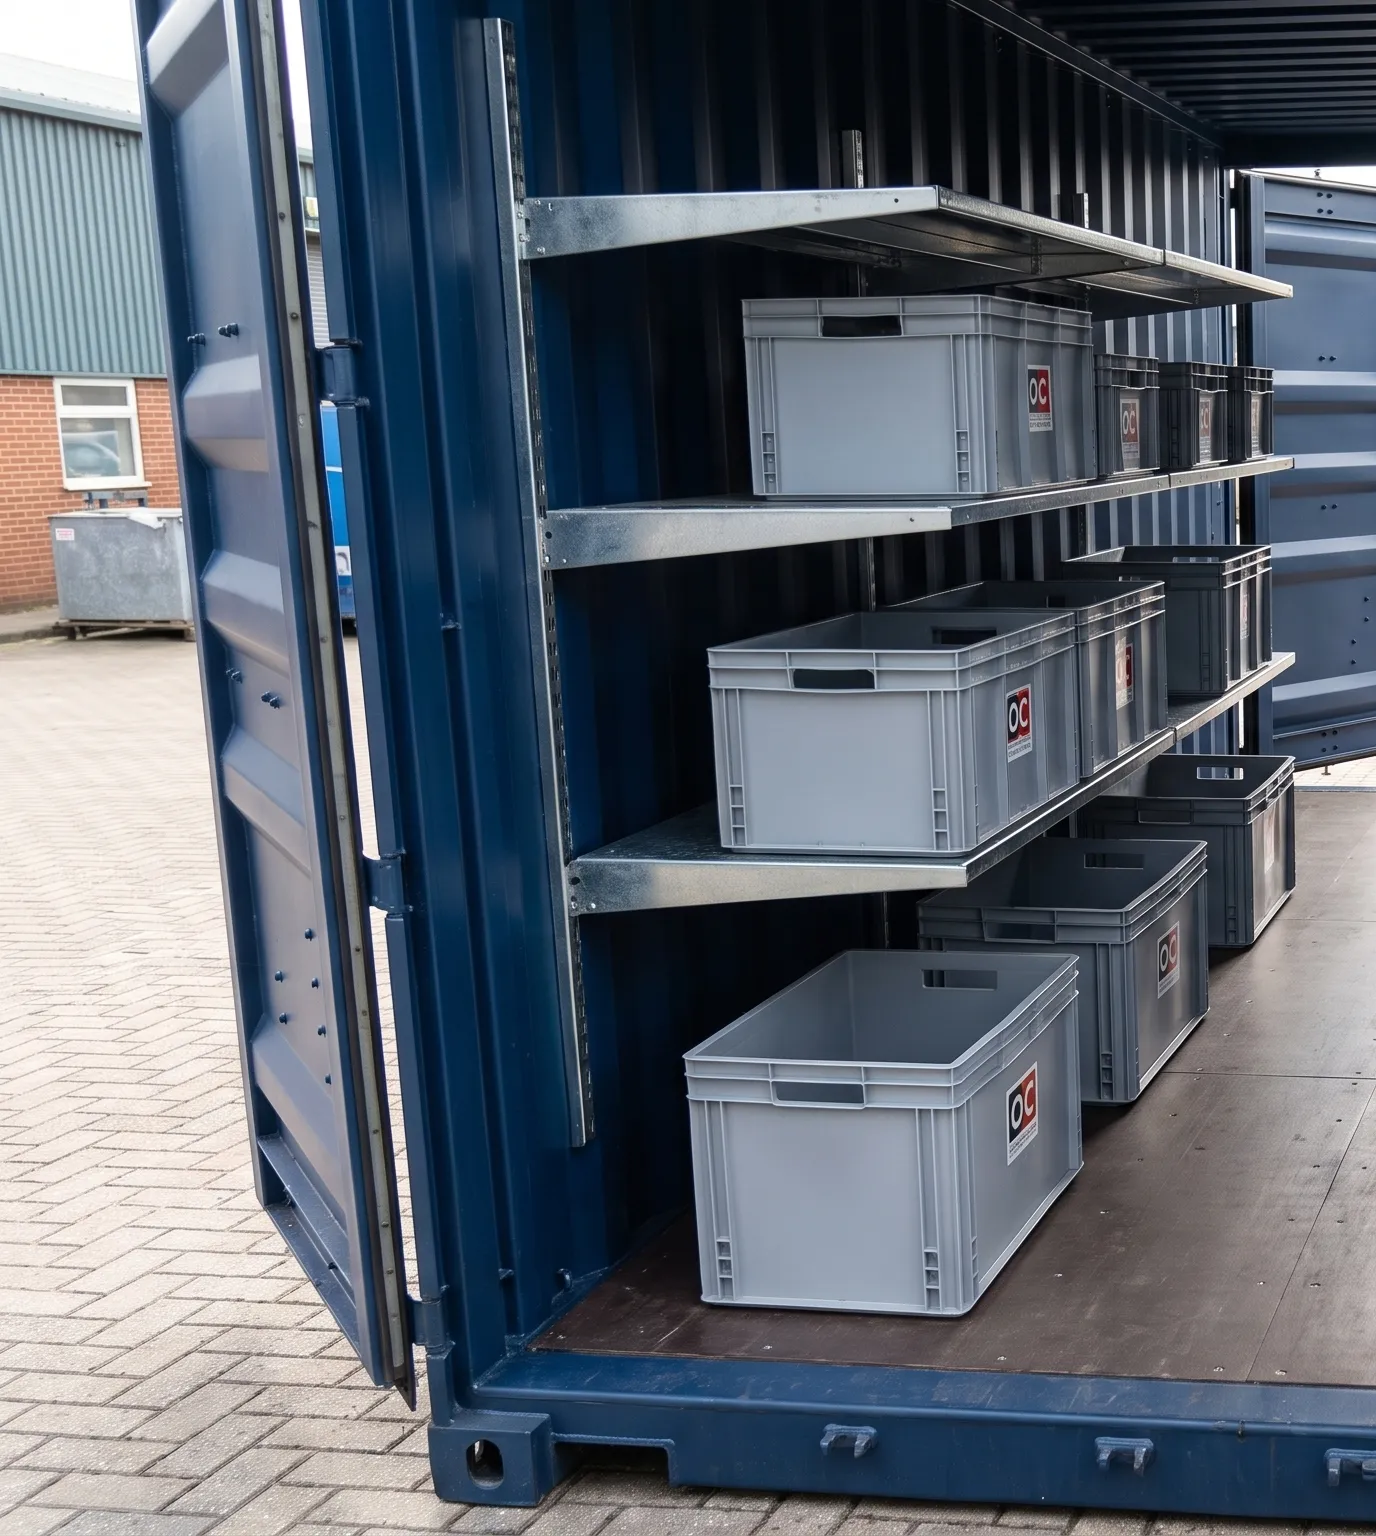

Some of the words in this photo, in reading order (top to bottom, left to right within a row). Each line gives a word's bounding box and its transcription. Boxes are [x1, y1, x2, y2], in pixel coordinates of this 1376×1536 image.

[1029, 377, 1047, 405] OC
[1122, 410, 1136, 435] OC
[1009, 697, 1028, 733] OC
[1160, 934, 1177, 972] OC
[1011, 1079, 1034, 1130] OC
